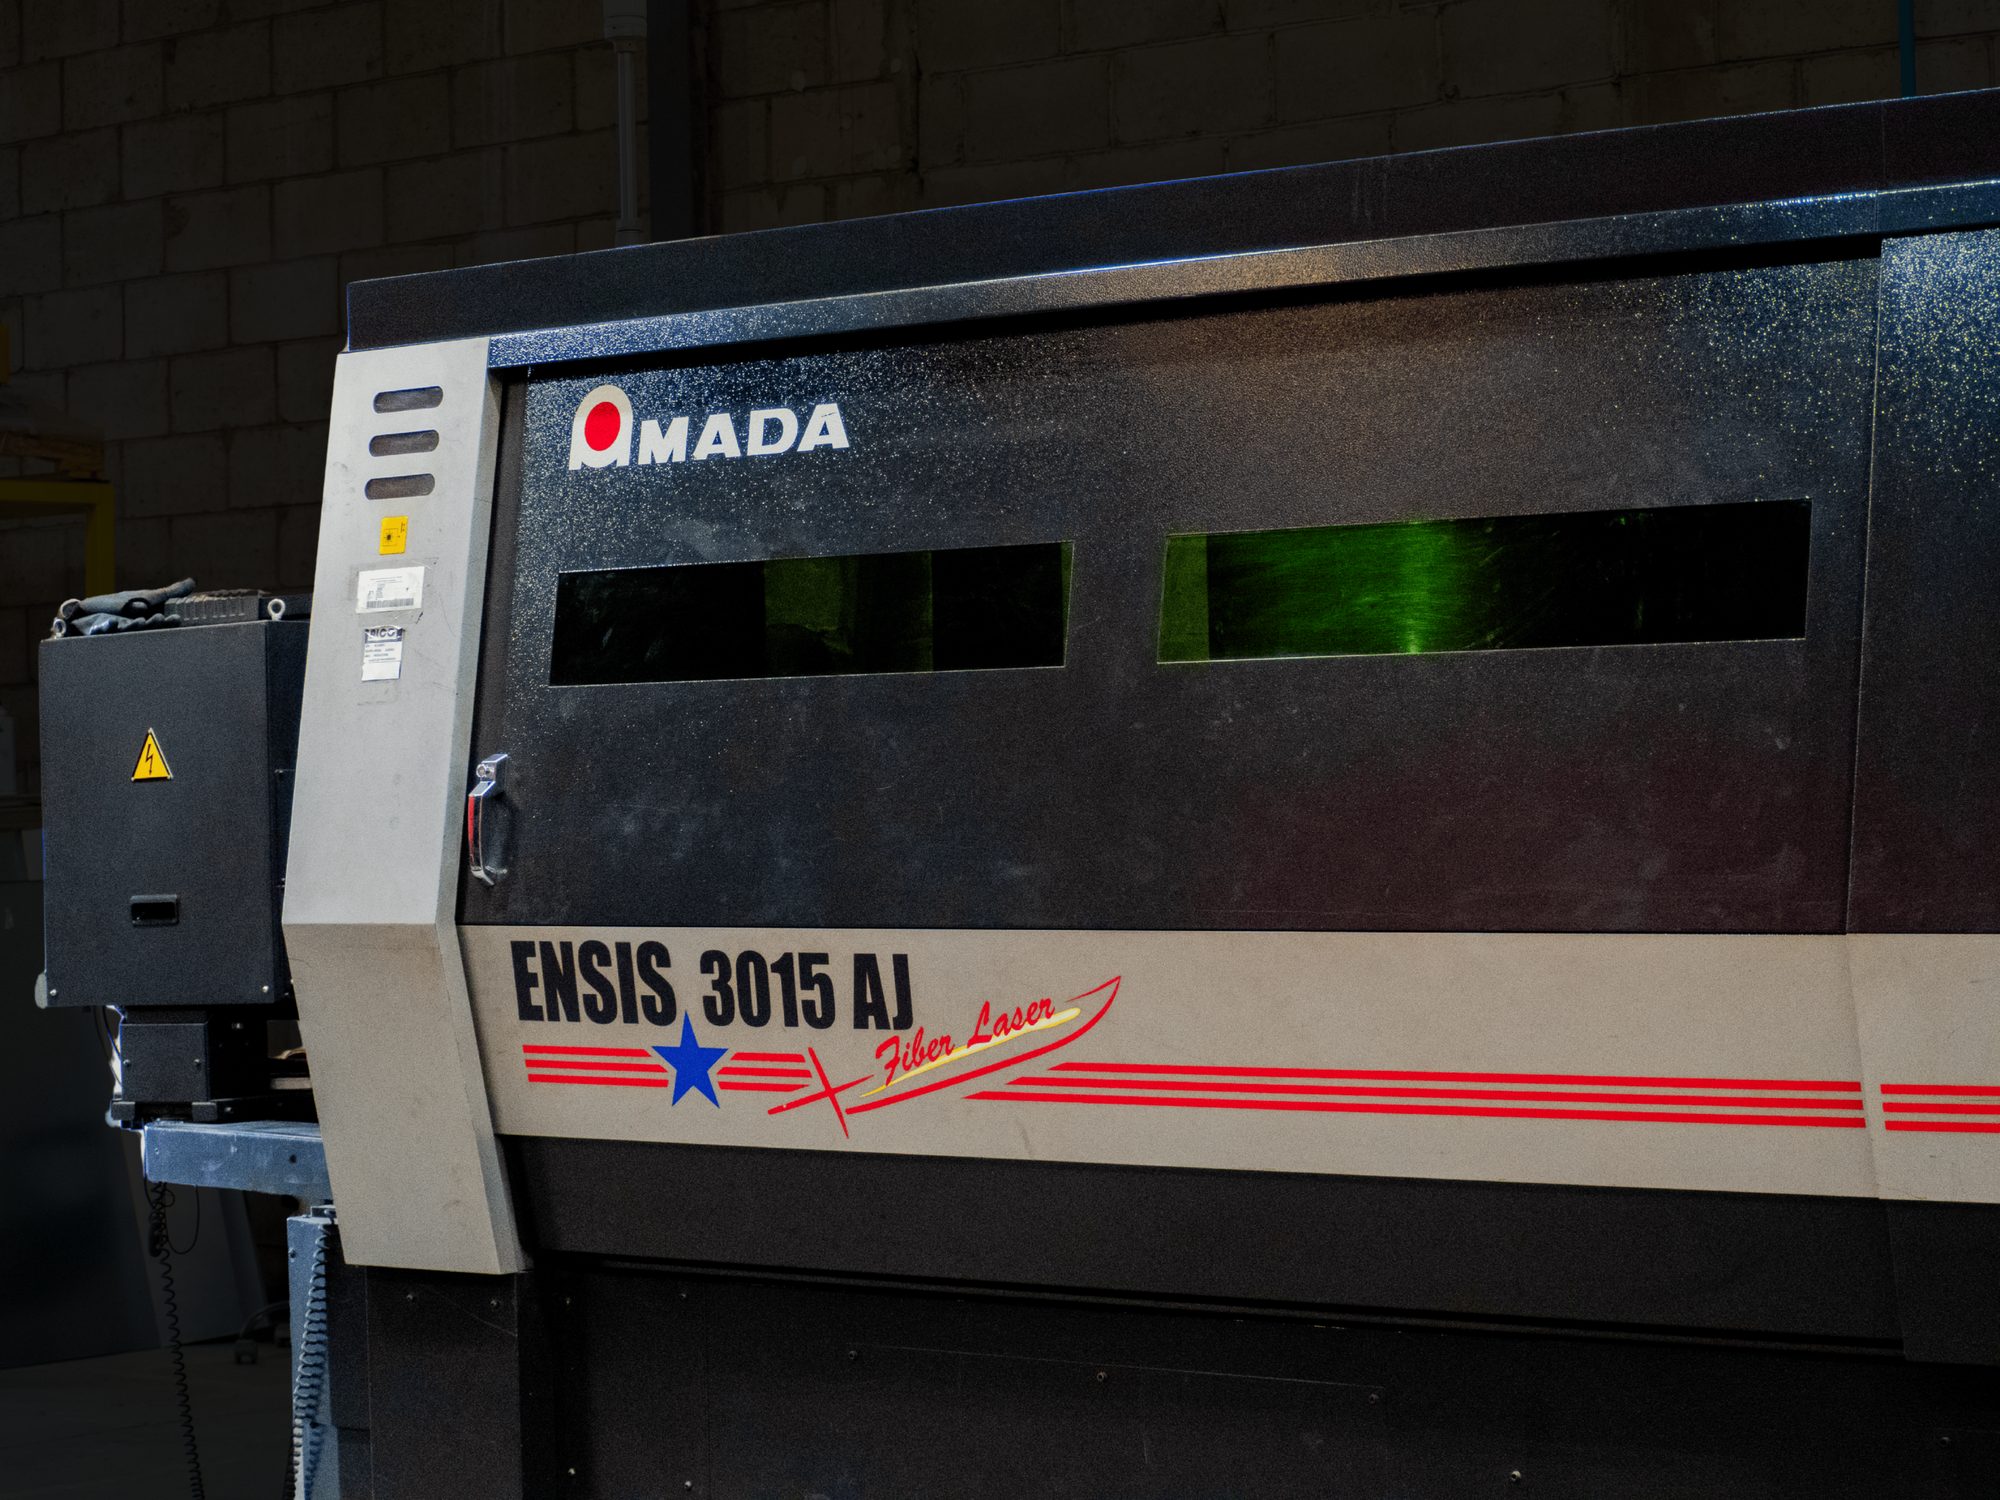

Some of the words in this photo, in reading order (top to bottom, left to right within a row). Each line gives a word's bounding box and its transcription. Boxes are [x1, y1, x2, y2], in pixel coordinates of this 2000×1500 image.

[569, 385, 849, 470] AMADA
[510, 940, 677, 1026] ENSIS
[700, 949, 836, 1029] 3015
[853, 953, 913, 1030] AJ
[876, 1029, 955, 1085] Fiber
[967, 996, 1055, 1046] Laser
